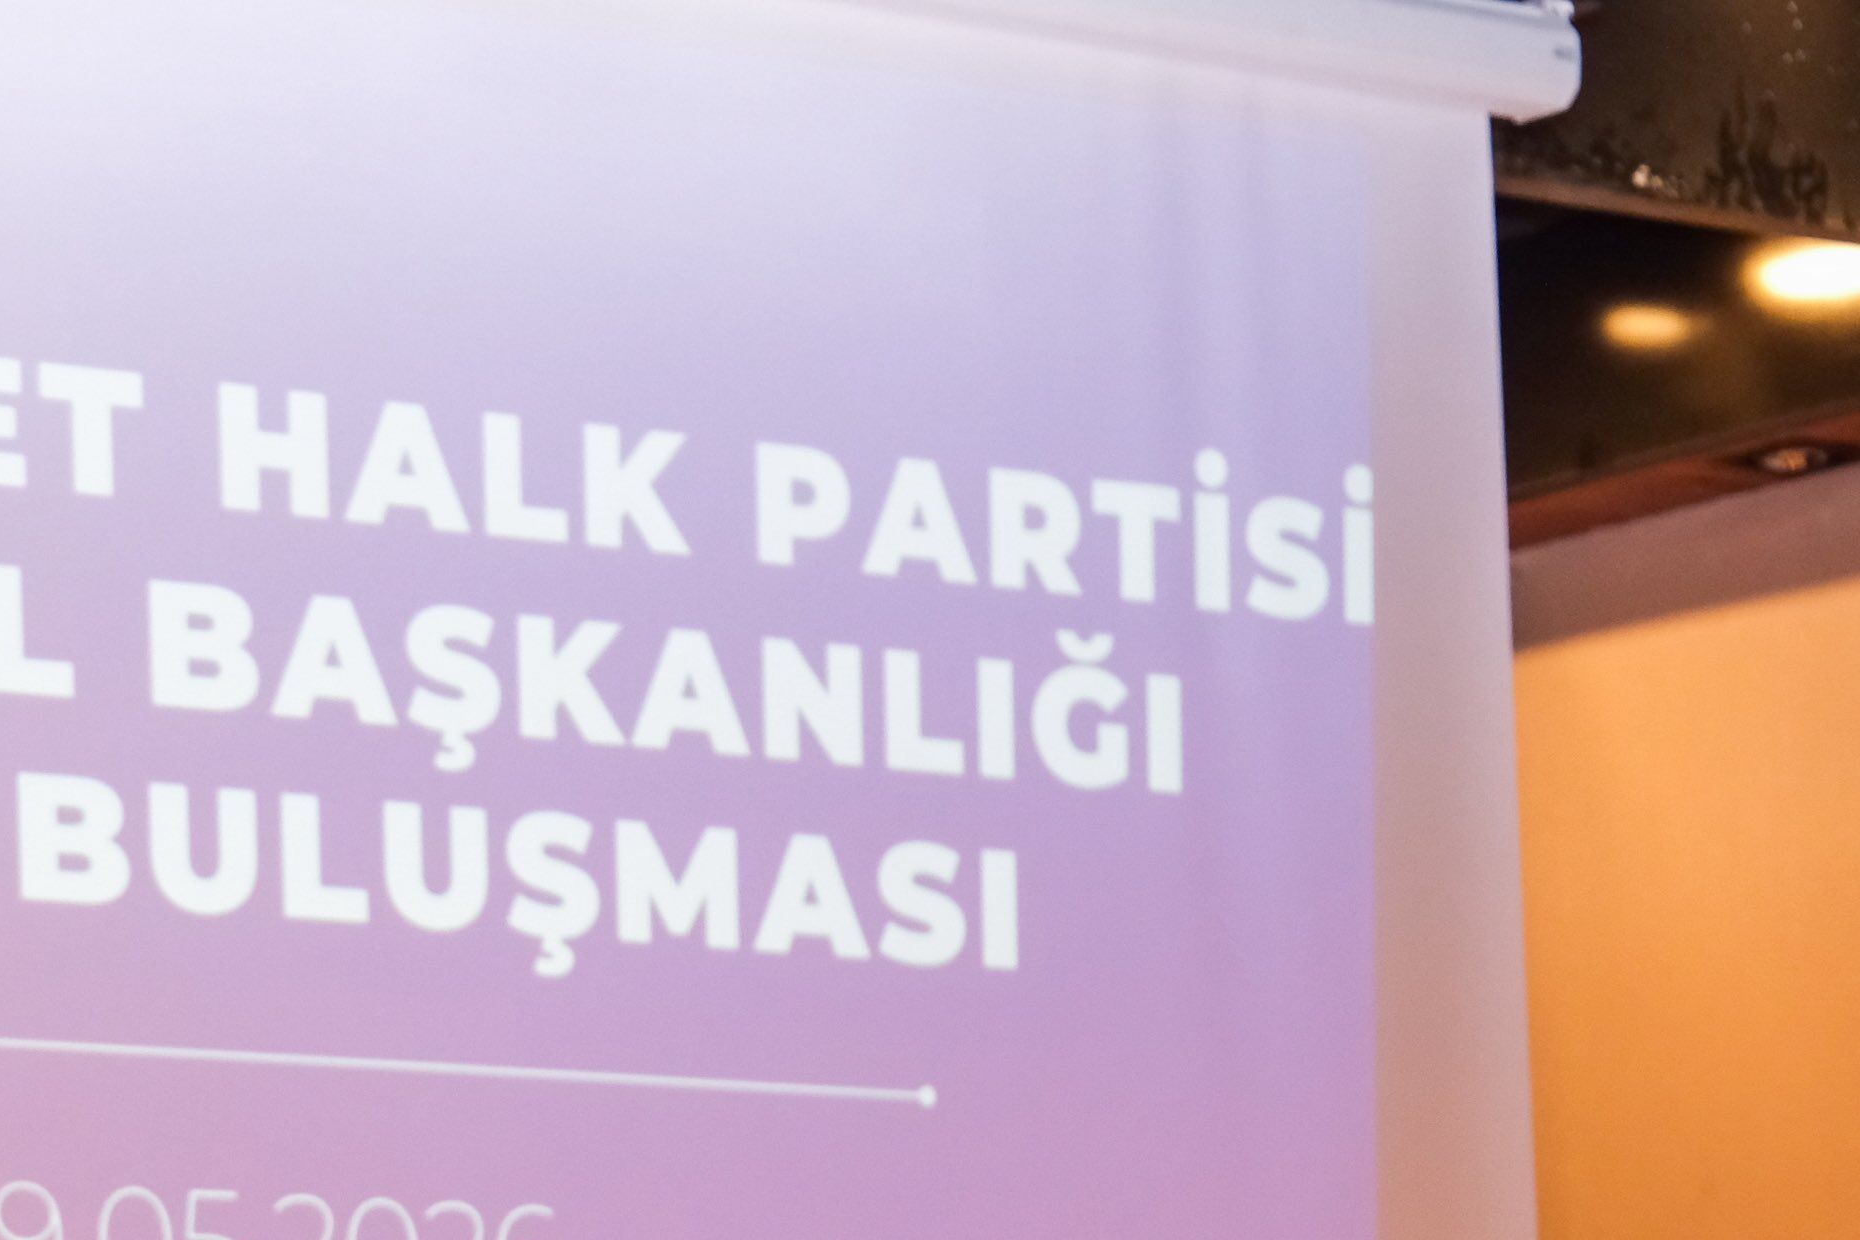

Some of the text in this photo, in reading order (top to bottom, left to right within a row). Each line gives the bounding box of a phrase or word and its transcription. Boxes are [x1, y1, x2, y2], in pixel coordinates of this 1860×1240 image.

[217, 381, 692, 557] HALK
[753, 440, 1374, 625] PARTİSİ
[146, 577, 1184, 794] BAŞKANLIĞI
[15, 771, 1020, 978] BULUŞMASI
